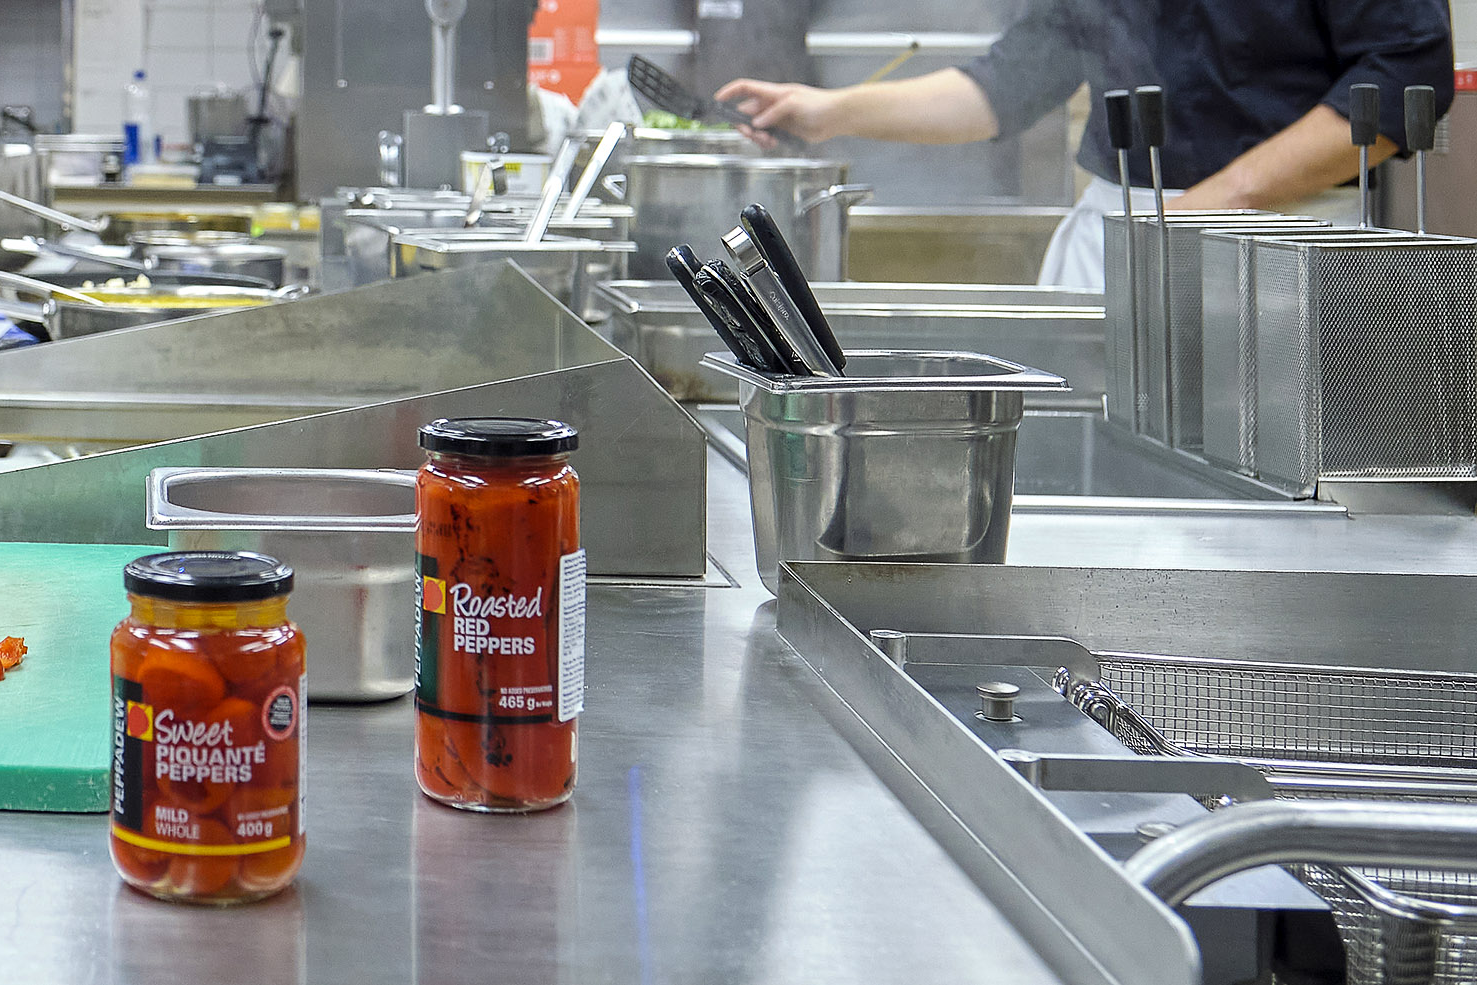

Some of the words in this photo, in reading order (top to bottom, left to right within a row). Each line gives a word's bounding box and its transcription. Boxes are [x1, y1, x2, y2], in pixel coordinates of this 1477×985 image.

[449, 583, 542, 618] Roasted
[454, 617, 490, 636] RED
[454, 634, 536, 655] PEPPERS
[499, 696, 524, 709] 465
[527, 697, 535, 711] g
[155, 709, 233, 746] Sweet
[113, 695, 125, 815] PEPPADEW
[156, 740, 266, 766] PIQUANTÉ
[156, 761, 252, 784] PEPPERS
[155, 805, 189, 823] MILD
[155, 822, 200, 839] WHOLE
